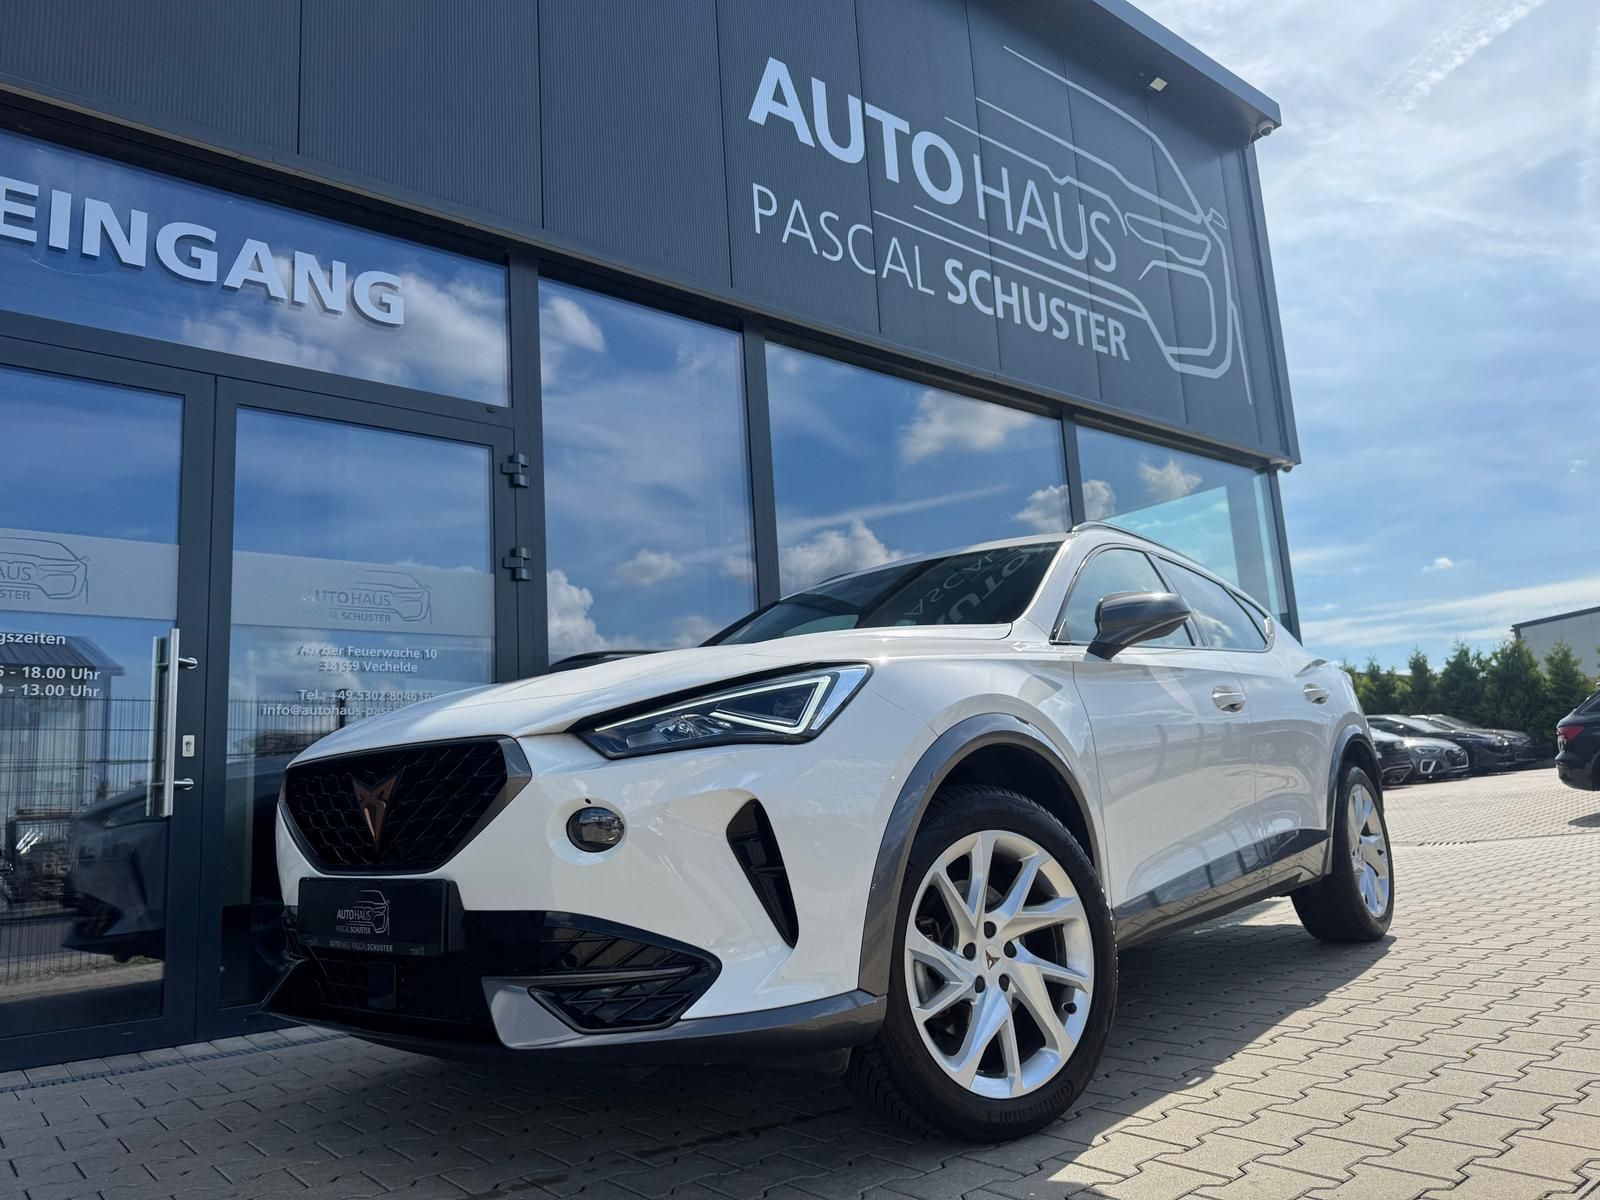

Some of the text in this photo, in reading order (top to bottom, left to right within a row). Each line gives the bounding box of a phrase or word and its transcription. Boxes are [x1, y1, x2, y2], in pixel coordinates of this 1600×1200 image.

[0, 176, 405, 325] EINGANG
[752, 182, 1130, 361] PASCAL SCHUSTER
[298, 589, 391, 607] UTOHAUS
[342, 611, 391, 623] SCHUSTER
[0, 631, 66, 646] gszeiten
[347, 646, 420, 658] Feuerwache
[425, 649, 437, 659] 10
[22, 665, 66, 679] 18.00
[71, 667, 101, 680] Uhr
[363, 661, 418, 673] Vechelde
[21, 683, 65, 696] 13.00
[70, 684, 100, 697] Uhr
[299, 688, 326, 700] Tel.:
[329, 689, 353, 700] +49
[337, 908, 371, 920] AUTOHAUS
[350, 926, 371, 934] SCHUSTER
[367, 943, 393, 952] SCHUSTER
